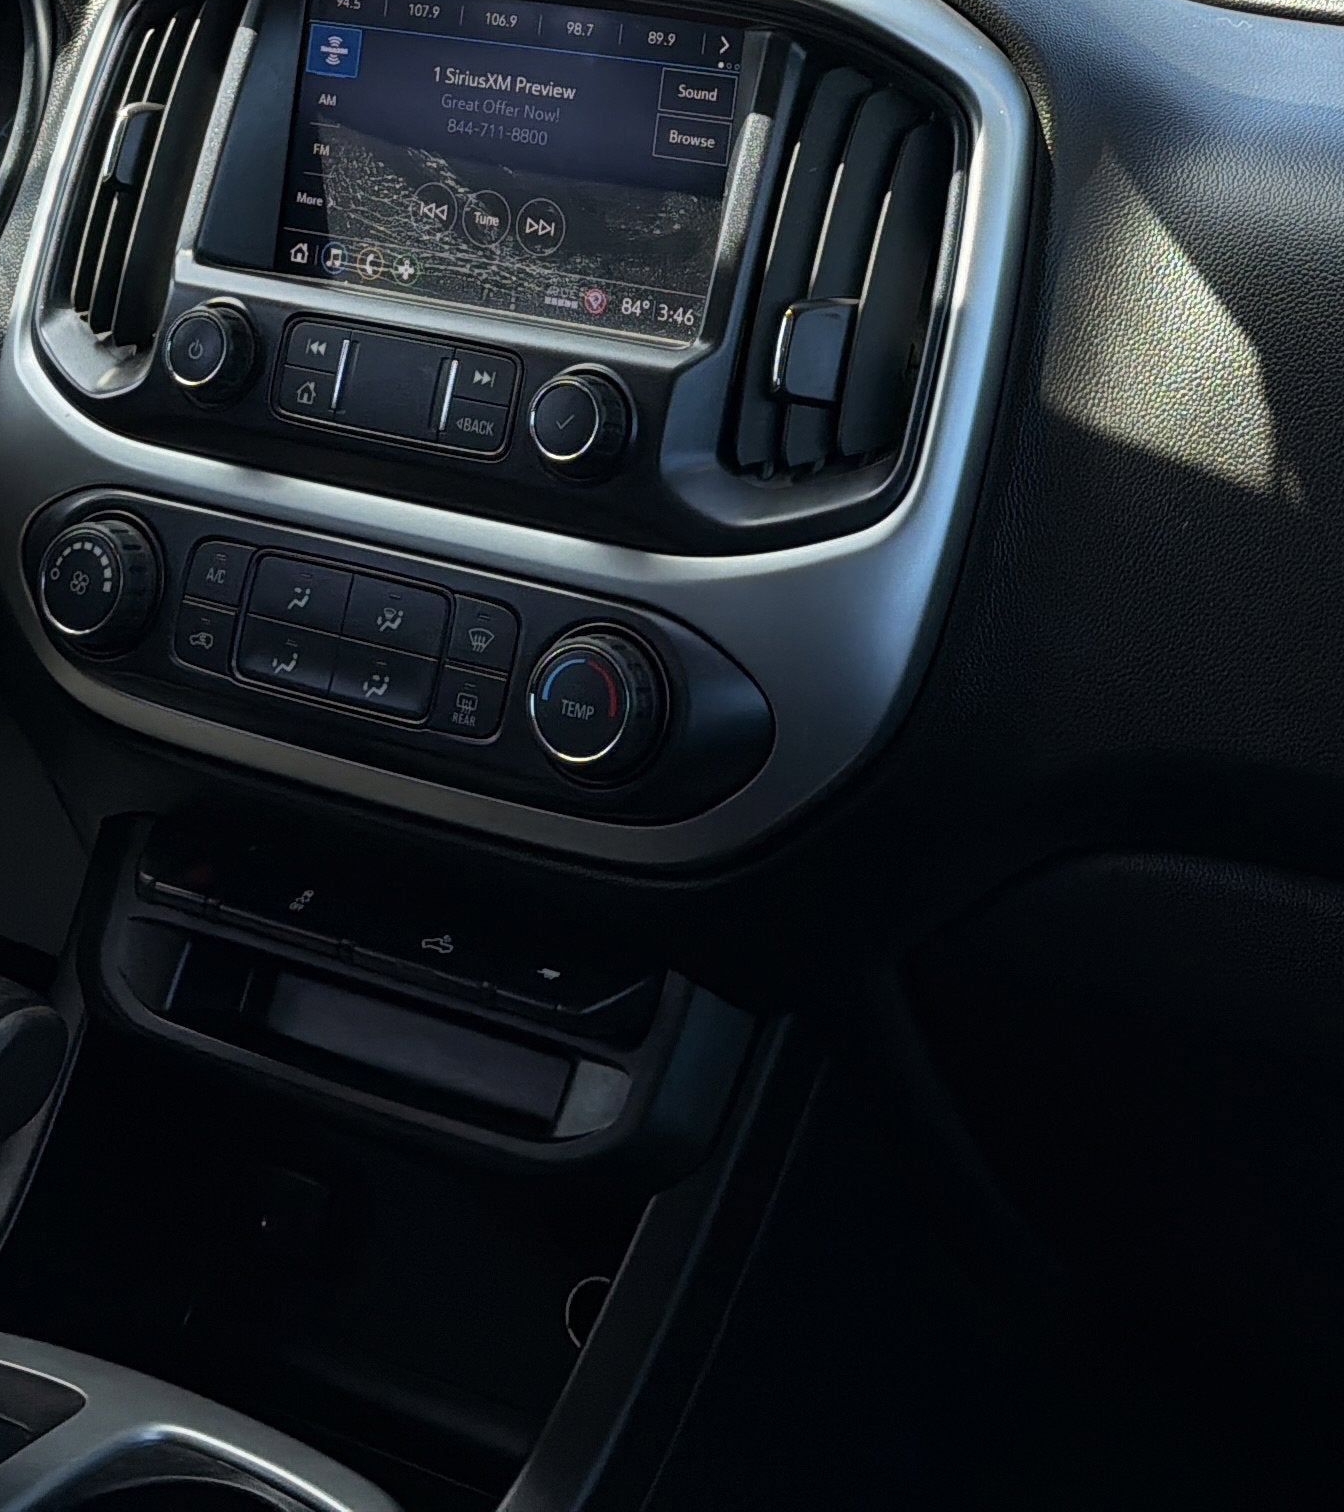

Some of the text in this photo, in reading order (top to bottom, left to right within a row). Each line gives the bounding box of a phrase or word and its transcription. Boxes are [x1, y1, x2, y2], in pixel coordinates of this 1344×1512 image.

[408, 3, 441, 19] 107.9
[485, 11, 518, 28] 106.9
[566, 21, 594, 37] 98.7
[647, 31, 676, 46] 89.9
[433, 66, 577, 100] 1 SiriusXM Preview
[677, 84, 718, 102] Sound
[318, 93, 337, 107] AM
[441, 93, 560, 123] Great Offer Now!
[447, 118, 548, 146] 844-711-8800
[669, 129, 716, 149] Browse
[313, 143, 330, 157] FM
[296, 191, 324, 207] More
[474, 211, 500, 227] Tune
[657, 303, 695, 326] 3:46
[463, 417, 495, 437] BACK
[206, 567, 226, 584] A/C
[452, 712, 476, 727] REAR
[561, 698, 595, 721] TEMP
